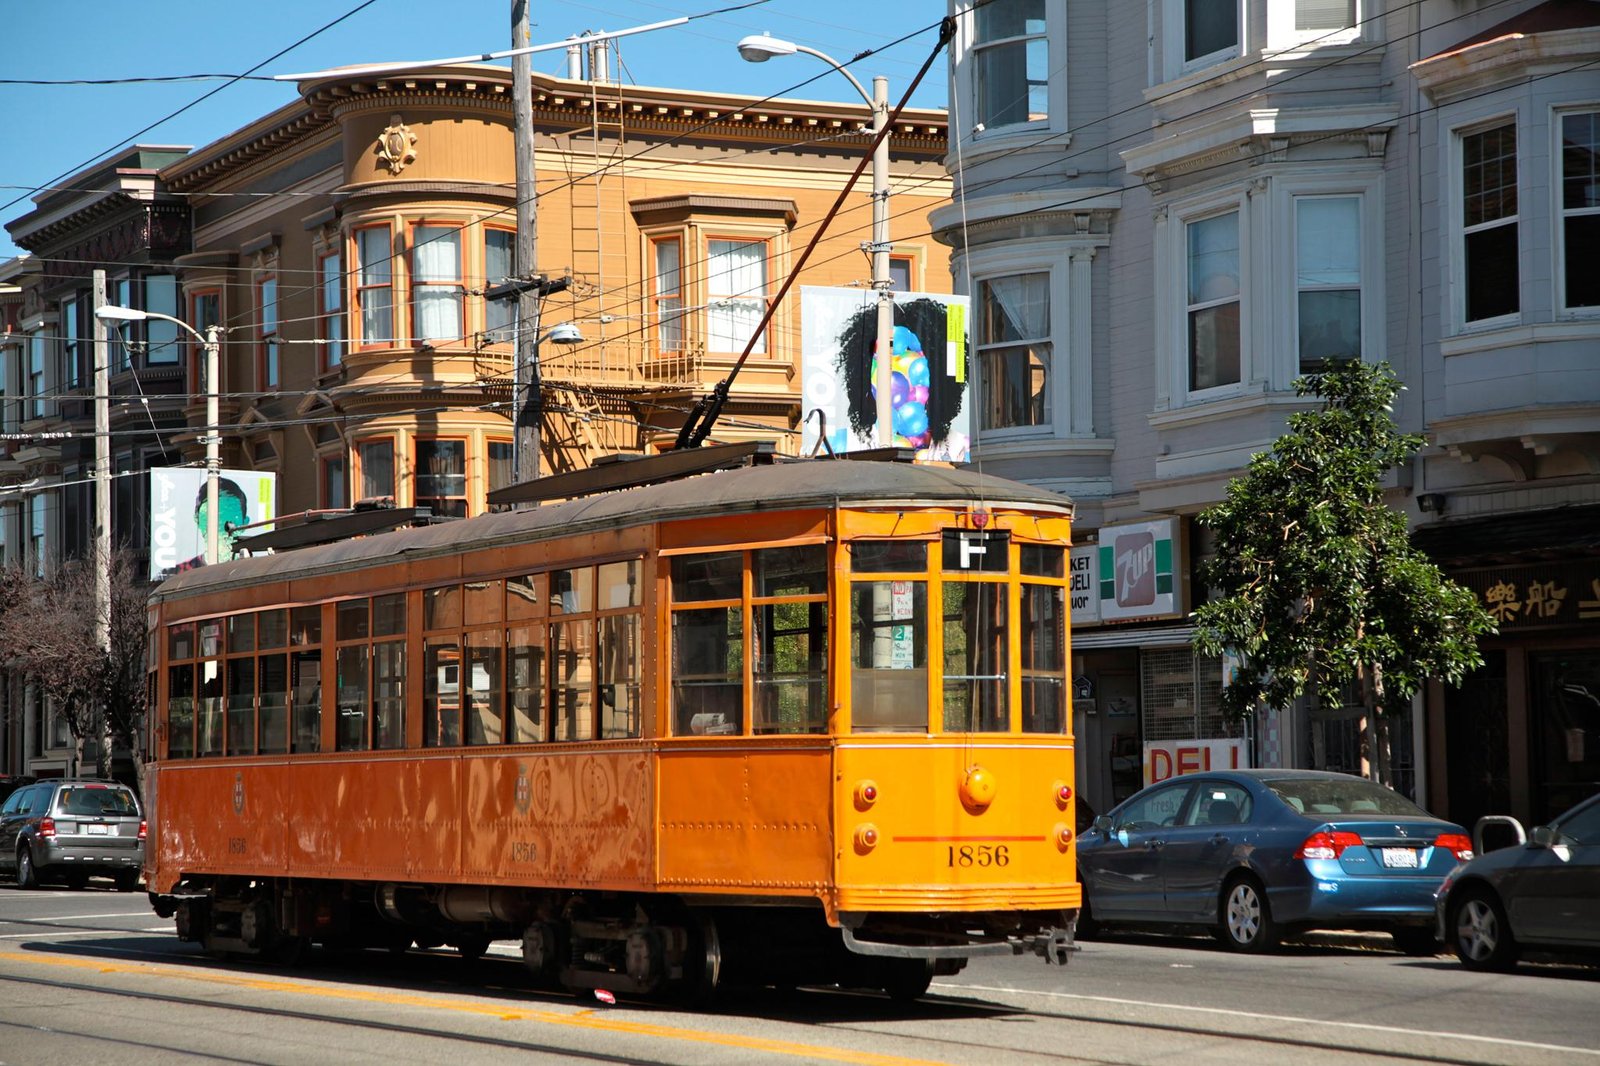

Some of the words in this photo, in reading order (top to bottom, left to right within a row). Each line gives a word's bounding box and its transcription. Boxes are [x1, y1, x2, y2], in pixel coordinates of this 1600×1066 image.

[806, 348, 837, 437] YOU
[155, 507, 176, 568] YOU
[960, 532, 989, 568] F
[1117, 543, 1153, 602] 7UP
[948, 845, 1010, 868] 1856
